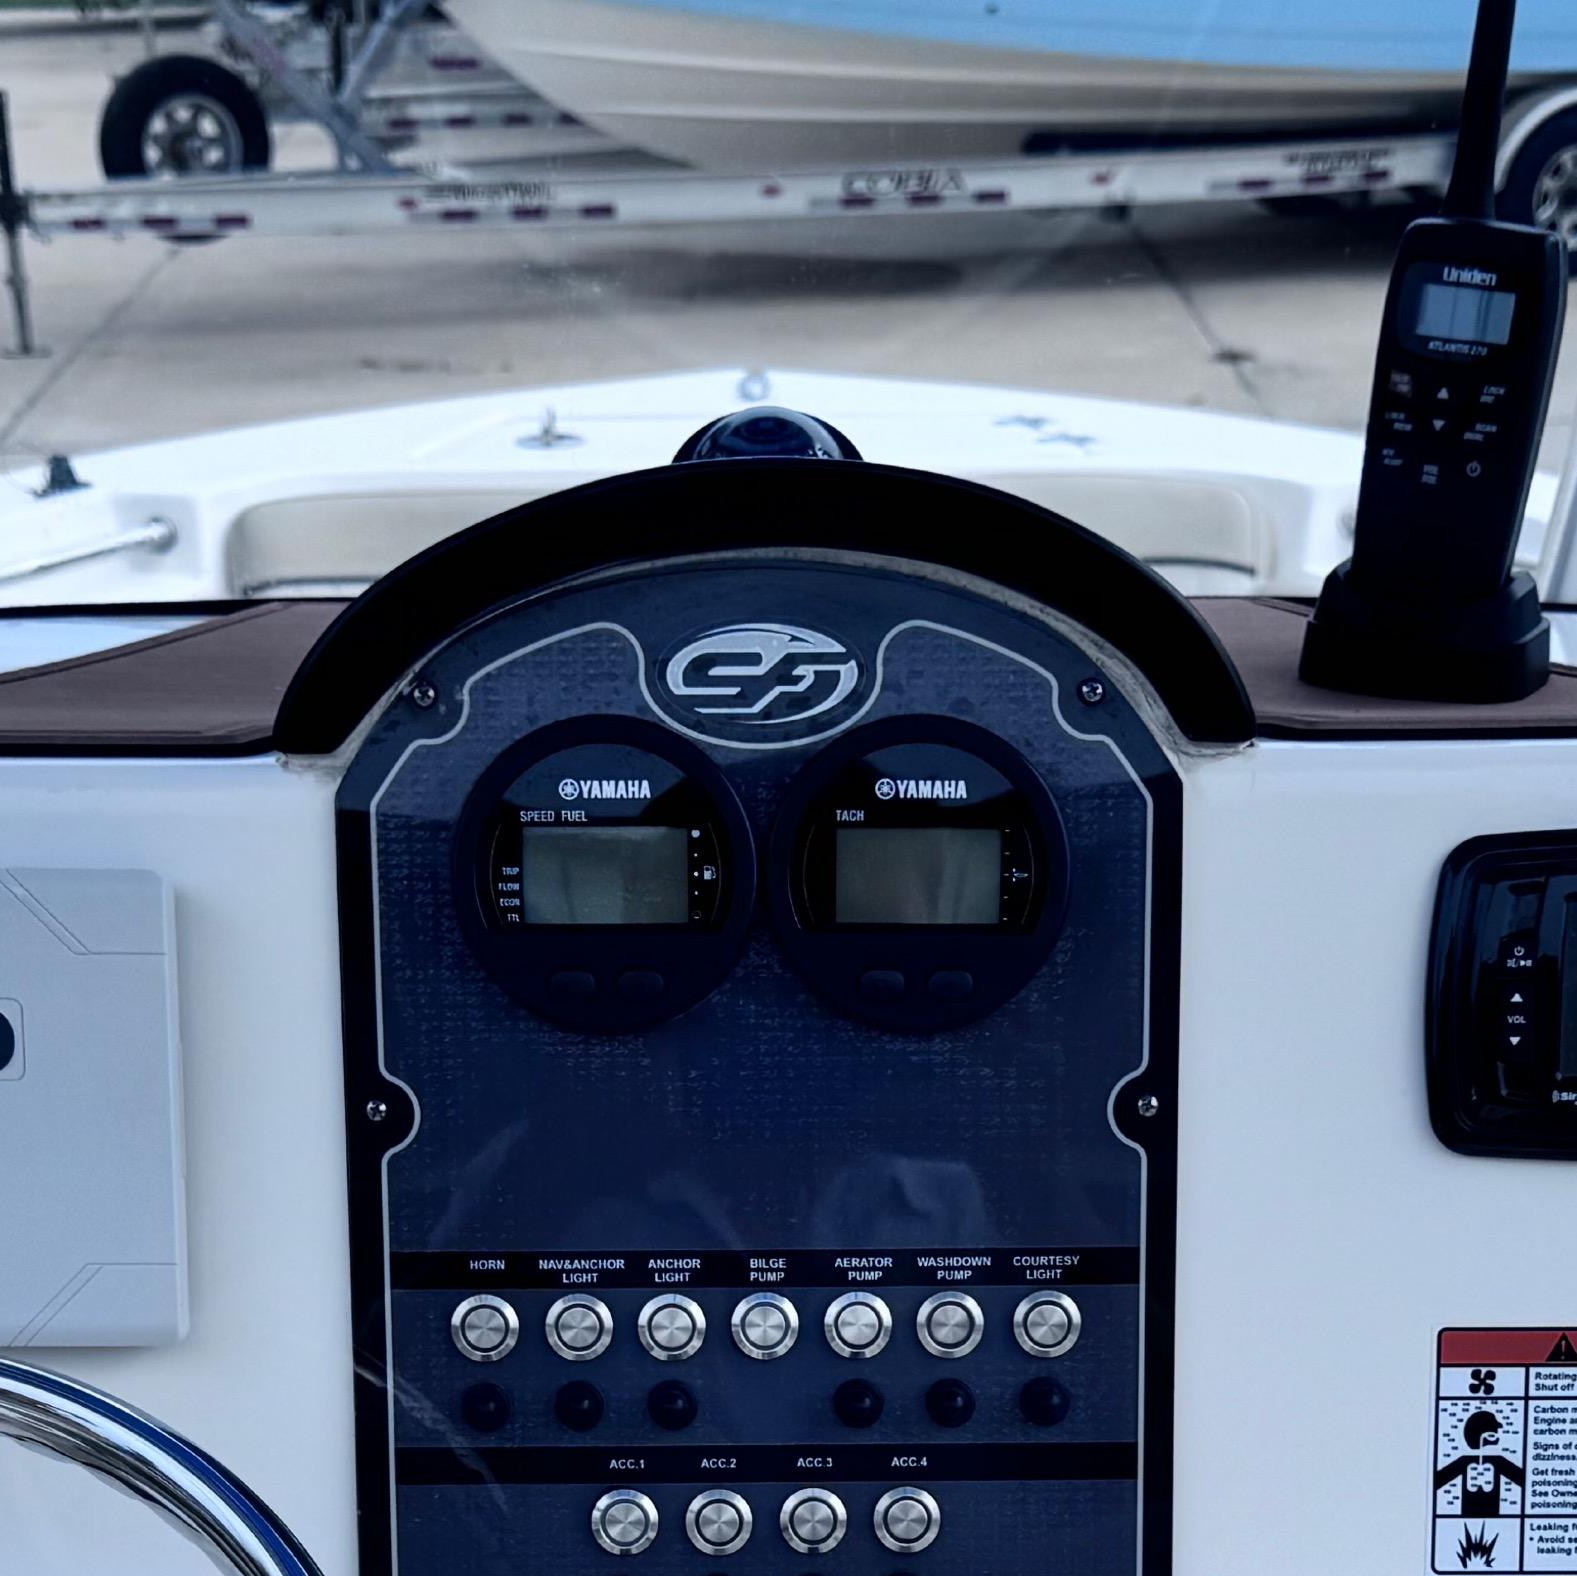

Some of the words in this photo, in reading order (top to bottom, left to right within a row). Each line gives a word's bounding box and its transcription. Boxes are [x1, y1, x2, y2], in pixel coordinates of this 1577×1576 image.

[1442, 265, 1497, 287] Uniden
[579, 779, 651, 798] YAMAHA
[896, 779, 967, 799] YAMAHA
[520, 810, 554, 822] SPEED
[561, 810, 587, 822] FUEL
[835, 809, 864, 821] TACH
[1507, 1015, 1526, 1023] VOL
[470, 1259, 505, 1269] HORN
[538, 1258, 624, 1269] NAV&ANCHOR
[648, 1258, 700, 1269] ANCHOR
[749, 1258, 786, 1268] BILGE
[834, 1257, 892, 1267] AERATOR
[917, 1256, 991, 1266] WASHDOWN
[1012, 1255, 1079, 1266] COURTESY
[562, 1272, 598, 1283] LIGHT
[654, 1272, 690, 1282] LIGHT
[749, 1271, 784, 1282] PUMP
[848, 1270, 882, 1280] PUMP
[937, 1269, 972, 1280] PUMP
[1026, 1269, 1062, 1279] LIGHT
[1534, 1371, 1577, 1382] Rotating
[1534, 1382, 1558, 1391] Shut
[1559, 1382, 1575, 1391] off
[1533, 1404, 1569, 1414] Carbon
[1533, 1415, 1567, 1426] Engine
[1533, 1426, 1566, 1435] carbon
[609, 1459, 644, 1469] ACC.1
[700, 1458, 736, 1468] ACC.2
[797, 1457, 832, 1467] ACC.3
[891, 1456, 927, 1467] ACC.4
[1529, 1522, 1569, 1533] Leaking
